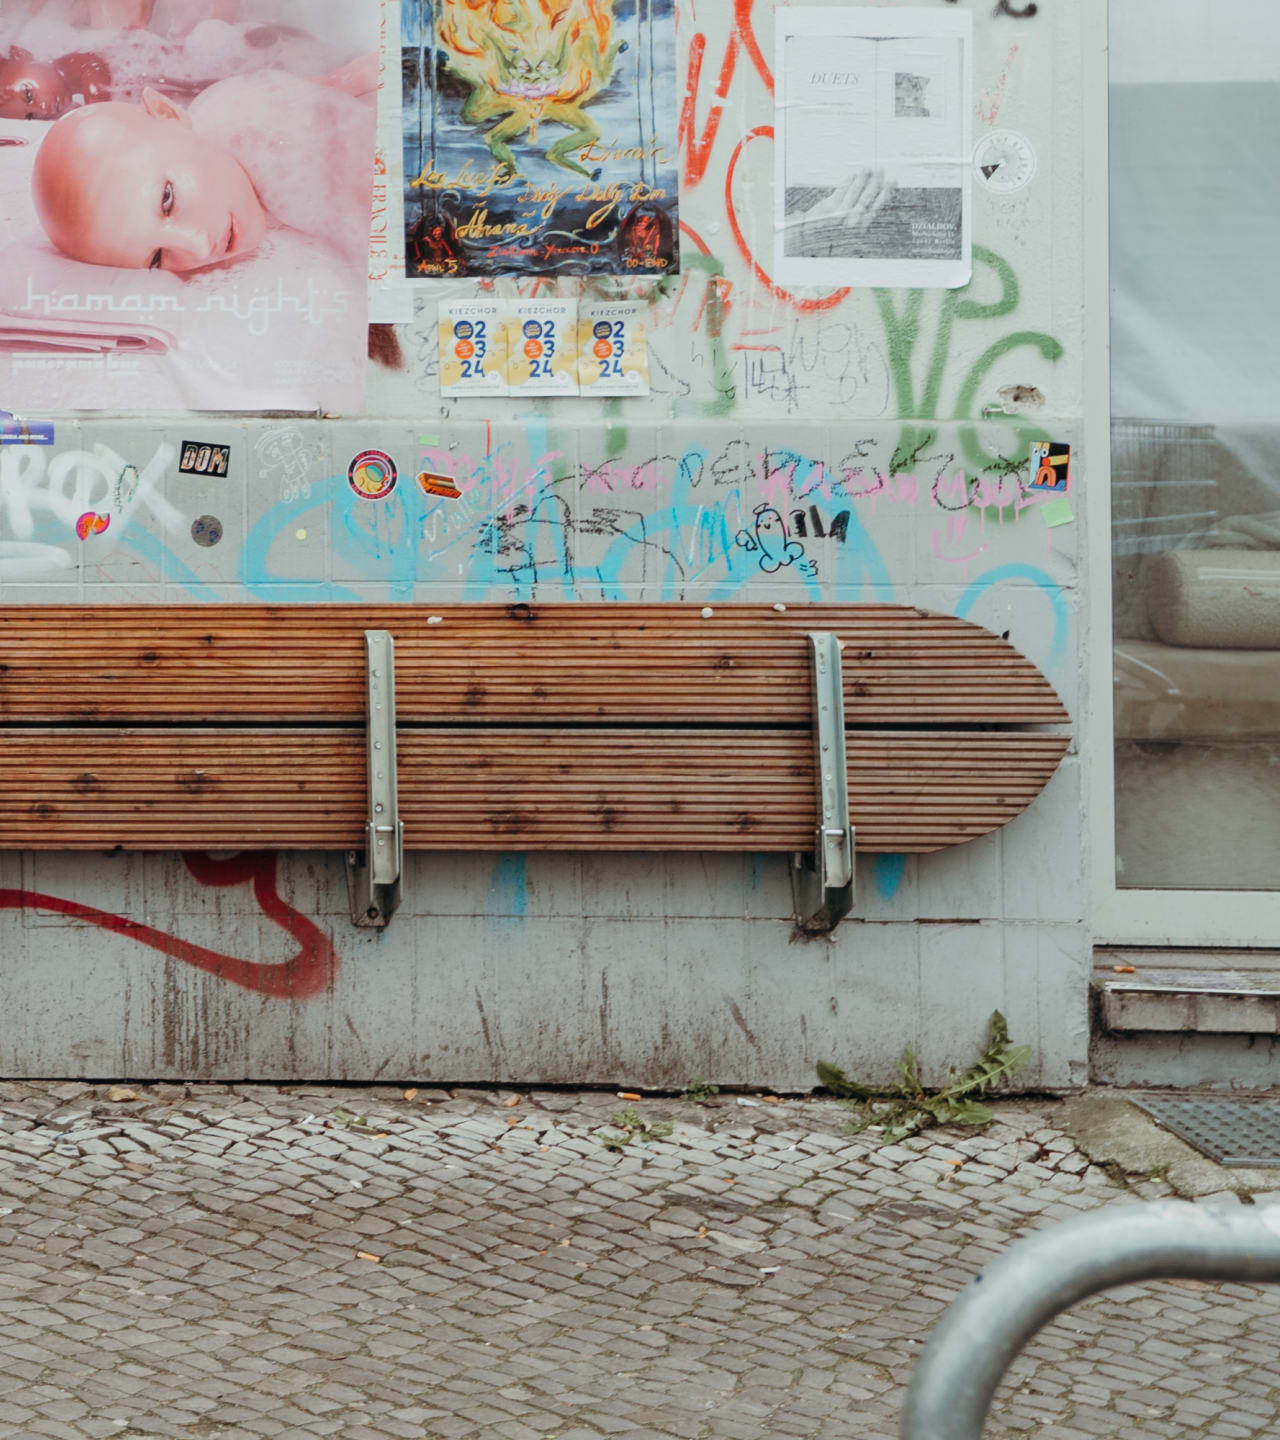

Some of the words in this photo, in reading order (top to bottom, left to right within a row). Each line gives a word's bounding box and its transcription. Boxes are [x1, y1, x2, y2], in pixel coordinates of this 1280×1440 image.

[809, 71, 860, 86] DUETS
[460, 360, 486, 378] 24
[529, 360, 554, 378] 24
[599, 360, 624, 378] 24
[180, 444, 229, 474] DOM
